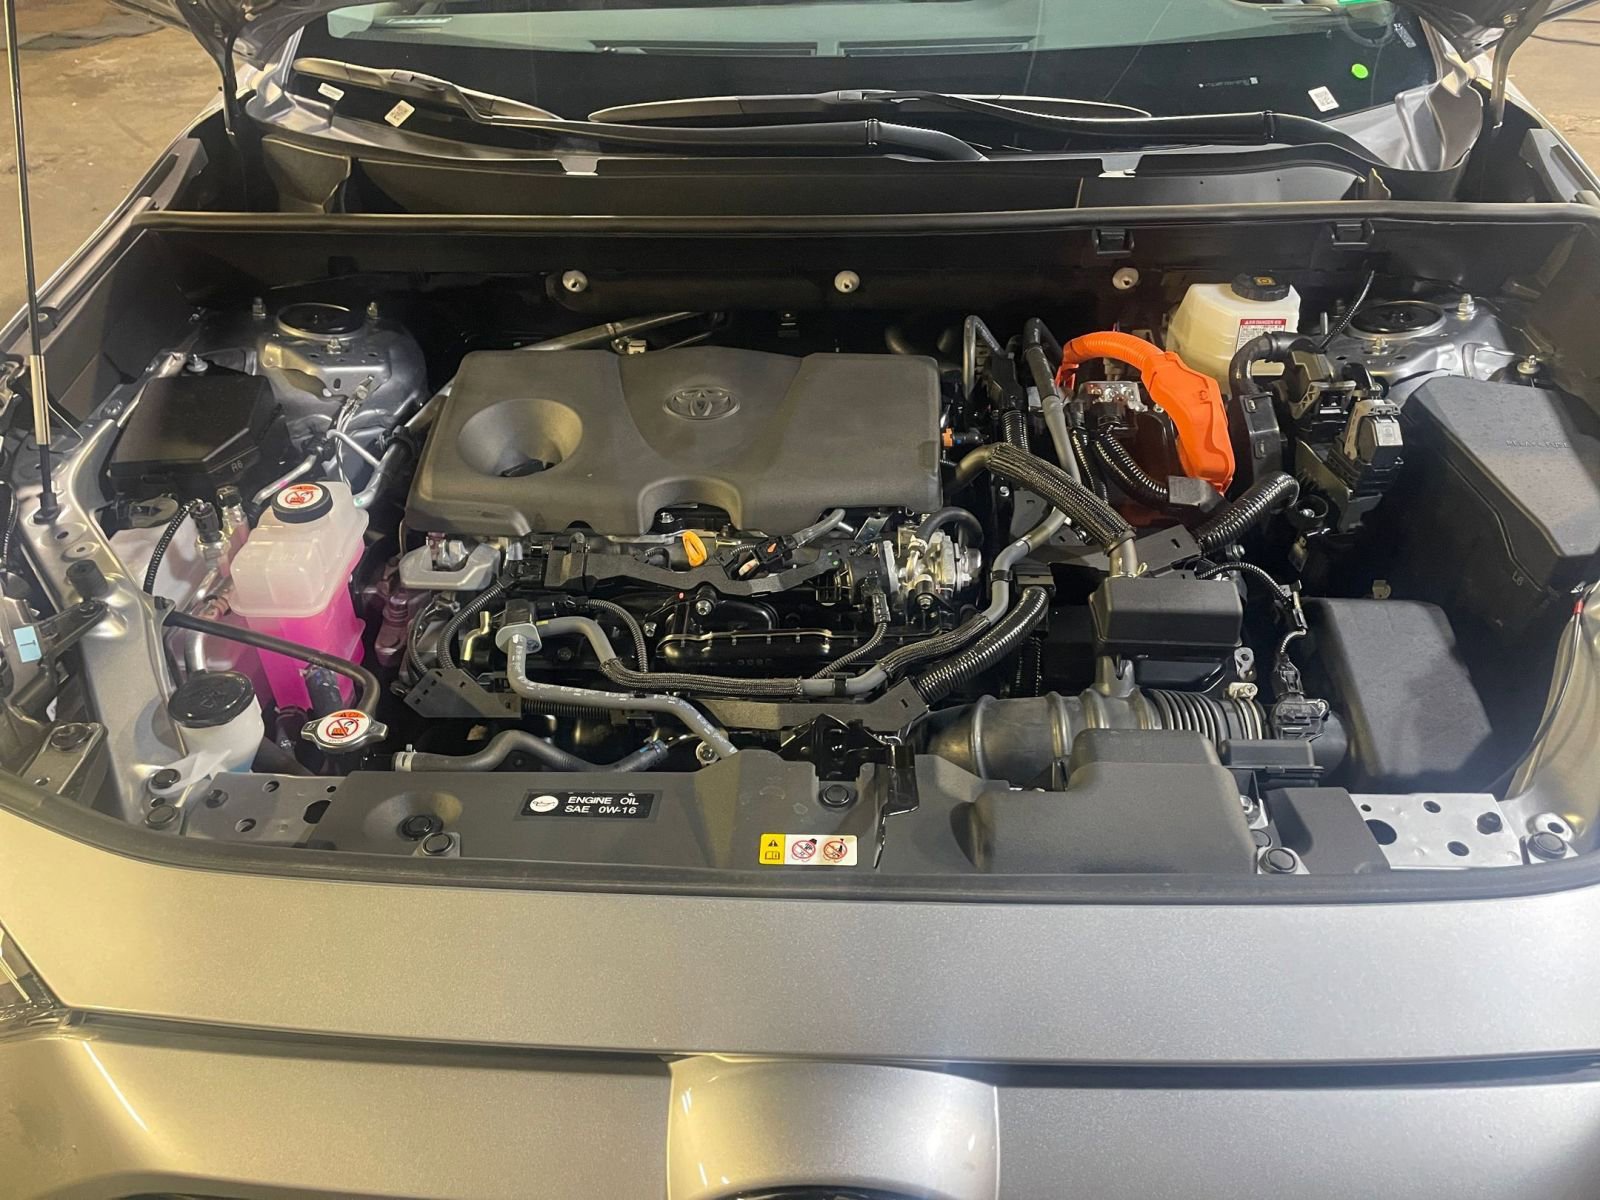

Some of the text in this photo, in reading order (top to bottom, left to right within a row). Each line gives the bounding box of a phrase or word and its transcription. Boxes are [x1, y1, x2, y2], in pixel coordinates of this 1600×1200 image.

[568, 796, 640, 805] ENGINE OIL
[564, 805, 591, 813] SAE
